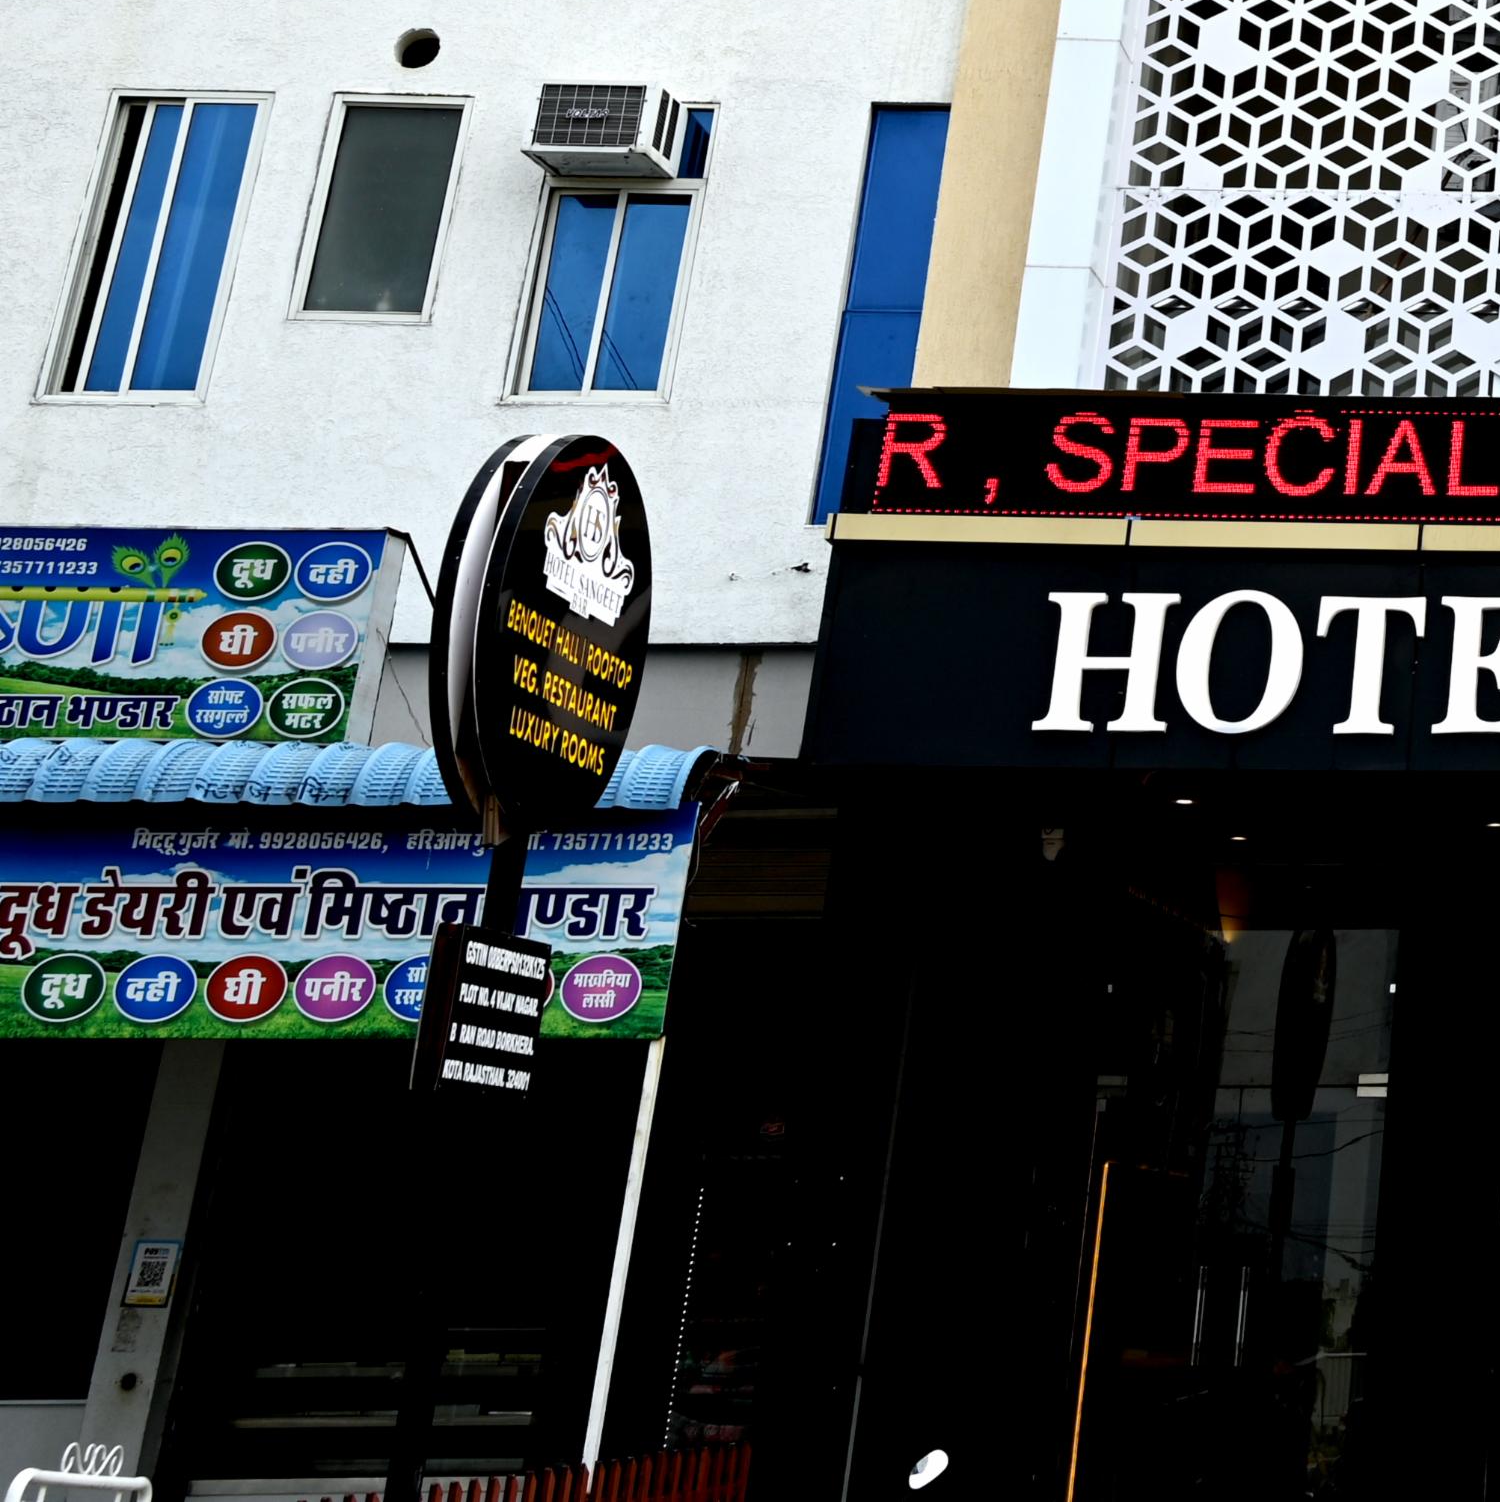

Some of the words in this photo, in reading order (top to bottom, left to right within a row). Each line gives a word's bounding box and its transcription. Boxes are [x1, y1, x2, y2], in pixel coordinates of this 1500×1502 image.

[1045, 410, 1498, 496] SPECIAL
[0, 537, 87, 552] 28056426
[232, 557, 278, 588] दूध
[308, 559, 359, 585] दही
[546, 551, 577, 590] HOTEL
[578, 573, 623, 616] SANGEET
[572, 596, 589, 618] BAR
[218, 623, 258, 656] घी
[289, 627, 348, 655] पनीर
[507, 599, 556, 650] BENQUET
[556, 626, 579, 664] HALL
[586, 643, 633, 691] ROOFTOP
[281, 689, 336, 709] सफल
[513, 654, 540, 696] VEG.
[544, 671, 618, 733] RESTAURANT
[66, 695, 182, 730] भण्डार
[284, 711, 326, 729] मटर
[509, 705, 560, 754] LUXURY
[561, 724, 606, 776] ROOMS
[259, 831, 389, 854] 9928056426,
[552, 833, 674, 852] 7357711233
[0, 881, 80, 962] दूध
[79, 866, 218, 940] डेयरी
[219, 866, 312, 940] एवं
[514, 884, 658, 941] ण्डार
[40, 971, 92, 1010] दूध
[126, 970, 182, 1003] दही
[223, 969, 267, 1005] घी
[304, 971, 366, 1002] पनीर
[459, 983, 478, 1004] PLOT
[496, 990, 517, 1013] VIJAY
[475, 1026, 497, 1049] ROAD
[442, 1059, 464, 1081] KOTA
